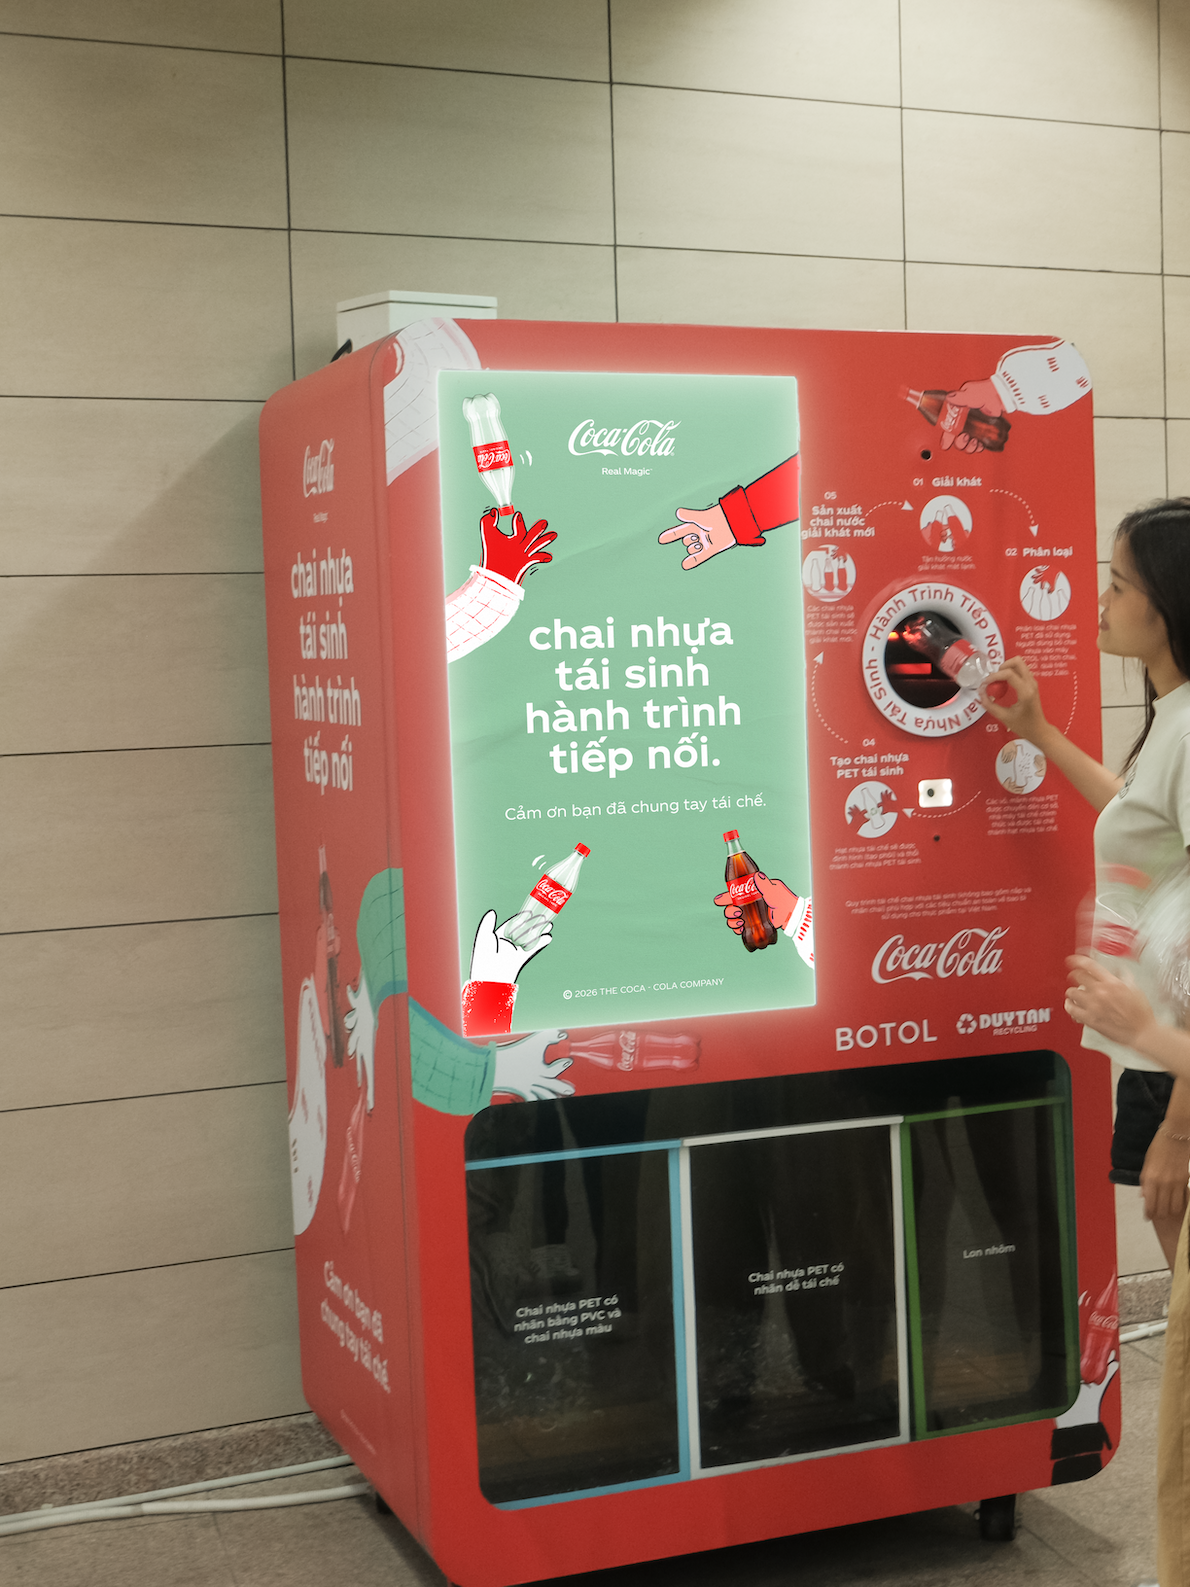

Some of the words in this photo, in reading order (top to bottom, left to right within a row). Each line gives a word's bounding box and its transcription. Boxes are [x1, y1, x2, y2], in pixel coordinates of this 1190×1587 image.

[568, 419, 682, 457] Coca-Cola
[601, 467, 622, 476] Real
[913, 478, 924, 487] 01
[931, 476, 954, 487] Giải
[956, 476, 983, 487] khát
[824, 491, 837, 500] 05
[812, 504, 834, 516] Sản
[836, 503, 863, 516] xuất
[810, 516, 834, 527] chai
[836, 516, 866, 527] nước
[800, 528, 822, 540] giải
[824, 527, 851, 537] khát
[853, 527, 876, 537] mới
[1005, 547, 1017, 557] 02
[1023, 546, 1051, 557] Phân
[1052, 546, 1073, 558] loại
[291, 548, 317, 599] chai
[320, 546, 354, 607] nhựa
[908, 585, 954, 602] Trình
[869, 599, 906, 640] Hành
[960, 594, 989, 629] Tiếp
[299, 611, 317, 660] tái
[319, 610, 348, 660] sinh
[529, 616, 615, 650] chai
[630, 616, 734, 655] nhựa
[555, 657, 610, 691] tái
[625, 656, 709, 689] sinh
[865, 658, 887, 700] Sinh
[293, 674, 325, 722] hành
[327, 675, 362, 727] trình
[526, 700, 630, 734] hành
[643, 695, 741, 729] trình
[883, 700, 907, 726] Tái
[914, 715, 962, 731] Nhựa
[986, 723, 999, 732] 03
[862, 738, 876, 747] 04
[303, 730, 329, 796] tiếp
[331, 734, 353, 792] nối
[549, 736, 633, 778] tiếp
[648, 732, 720, 770] nối.
[830, 756, 852, 768] Tạo
[854, 753, 878, 765] chai
[880, 753, 910, 765] nhựa
[837, 768, 859, 779] PET
[861, 767, 877, 777] tái
[880, 766, 904, 777] sinh
[505, 805, 542, 821] Cảm
[547, 806, 567, 818] ơn
[572, 804, 602, 819] bạn
[606, 801, 627, 815] đã
[631, 800, 679, 814] chung
[683, 799, 708, 812] tay
[712, 796, 731, 809] tái
[736, 792, 767, 807] chế.
[871, 926, 1011, 984] Coca-Cola
[574, 989, 598, 998] 2026
[600, 987, 618, 995] THE
[620, 985, 646, 993] COCA
[653, 982, 678, 991] COLA
[680, 978, 725, 989] COMPANY
[979, 1007, 1051, 1030] DUYTAN
[835, 1019, 938, 1052] BOTOL
[993, 1024, 1038, 1036] RECYCLING
[963, 1248, 983, 1259] Lon
[984, 1243, 1016, 1256] nhôm
[748, 1270, 774, 1283] Chai
[776, 1268, 805, 1280] nhựa
[807, 1264, 829, 1276] PET
[830, 1262, 845, 1273] có
[802, 1278, 817, 1289] tái
[819, 1275, 840, 1287] chế
[516, 1304, 543, 1318] Chai
[545, 1302, 577, 1314] nhựa
[578, 1297, 602, 1309] PET
[603, 1294, 619, 1306] có
[580, 1310, 606, 1323] PVC
[524, 1331, 550, 1344] chai
[552, 1328, 584, 1340] nhựa
[585, 1323, 612, 1335] màu
